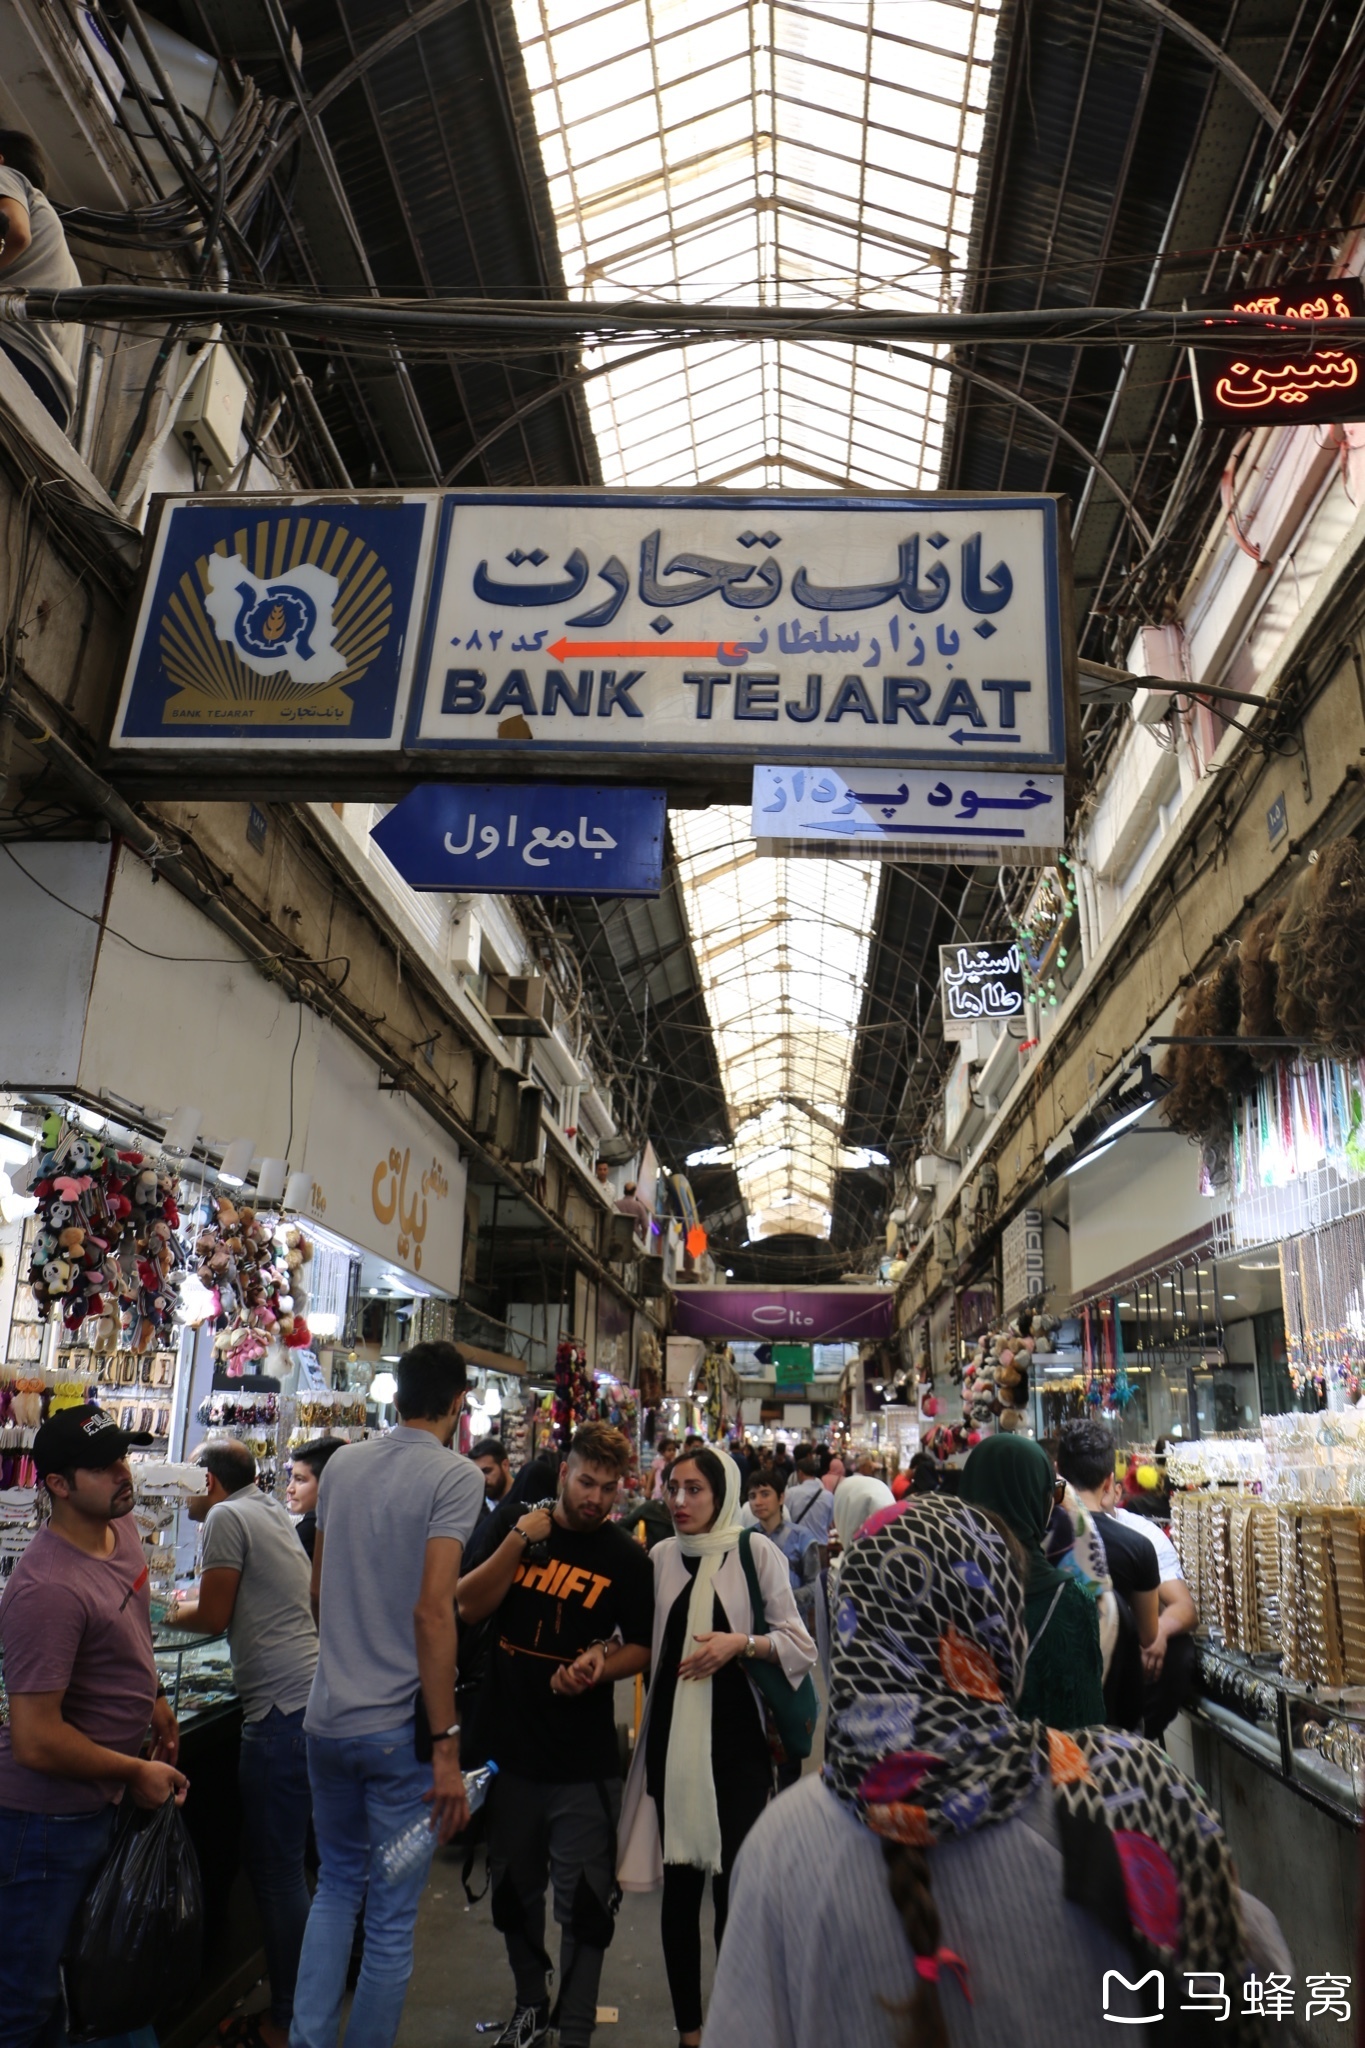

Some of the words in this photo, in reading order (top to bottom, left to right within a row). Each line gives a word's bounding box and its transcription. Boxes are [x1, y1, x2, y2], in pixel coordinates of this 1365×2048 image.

[473, 528, 783, 636] تجارت
[791, 530, 1014, 640] بانک
[511, 629, 549, 652] کد
[716, 615, 860, 667] سلطانی
[863, 614, 960, 671] بازار
[171, 709, 202, 719] BANK
[207, 709, 255, 719] TEJARAT
[280, 706, 317, 721] تجارت
[440, 668, 645, 718] BANK
[683, 672, 1032, 729] TEJARAT
[762, 769, 910, 819] پرداز
[926, 779, 1054, 819] خود
[444, 814, 518, 860] اول
[522, 816, 618, 867] جامع
[944, 944, 1020, 986] استیل
[948, 981, 1022, 1018] طاها
[371, 1147, 428, 1273] بیات
[752, 1305, 814, 1326] Clio
